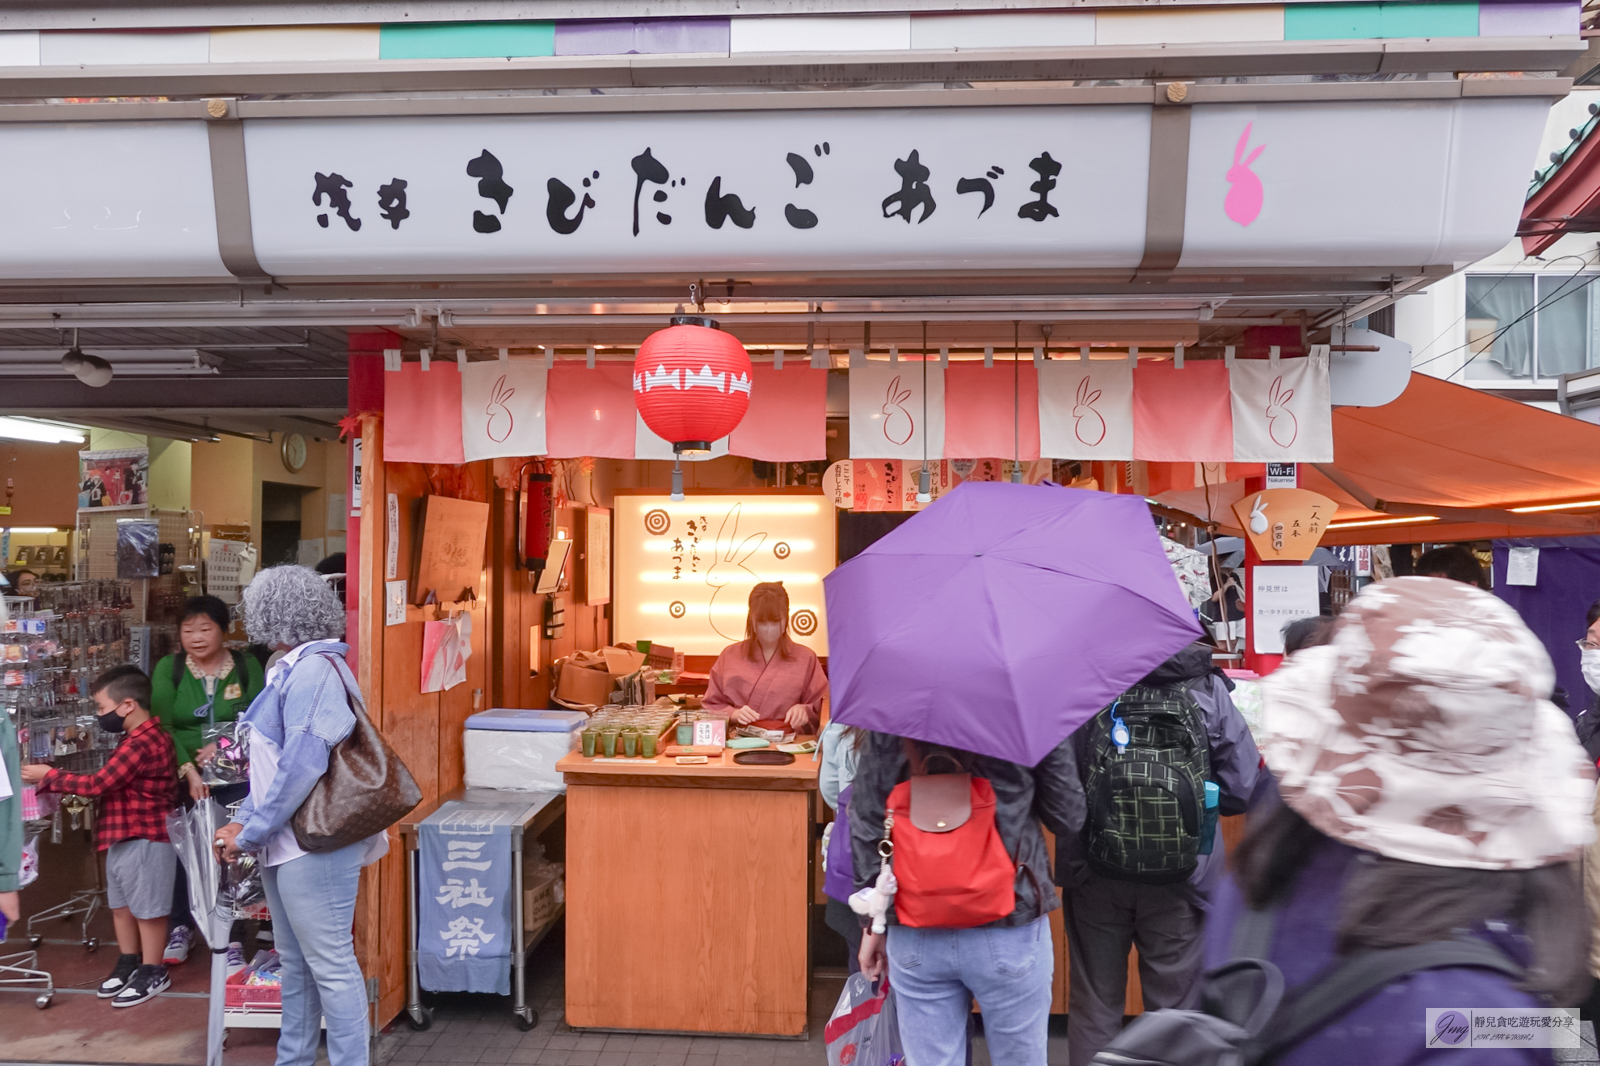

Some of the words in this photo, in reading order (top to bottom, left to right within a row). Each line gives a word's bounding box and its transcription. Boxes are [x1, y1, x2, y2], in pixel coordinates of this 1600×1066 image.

[466, 141, 833, 238] きびだんご
[881, 148, 1063, 225] あづま
[1269, 466, 1294, 476] Wi-Fi
[1291, 519, 1301, 538] 五本
[670, 537, 684, 580] あづま
[1257, 585, 1289, 593] 仲見世は
[435, 839, 496, 961] 三社祭
